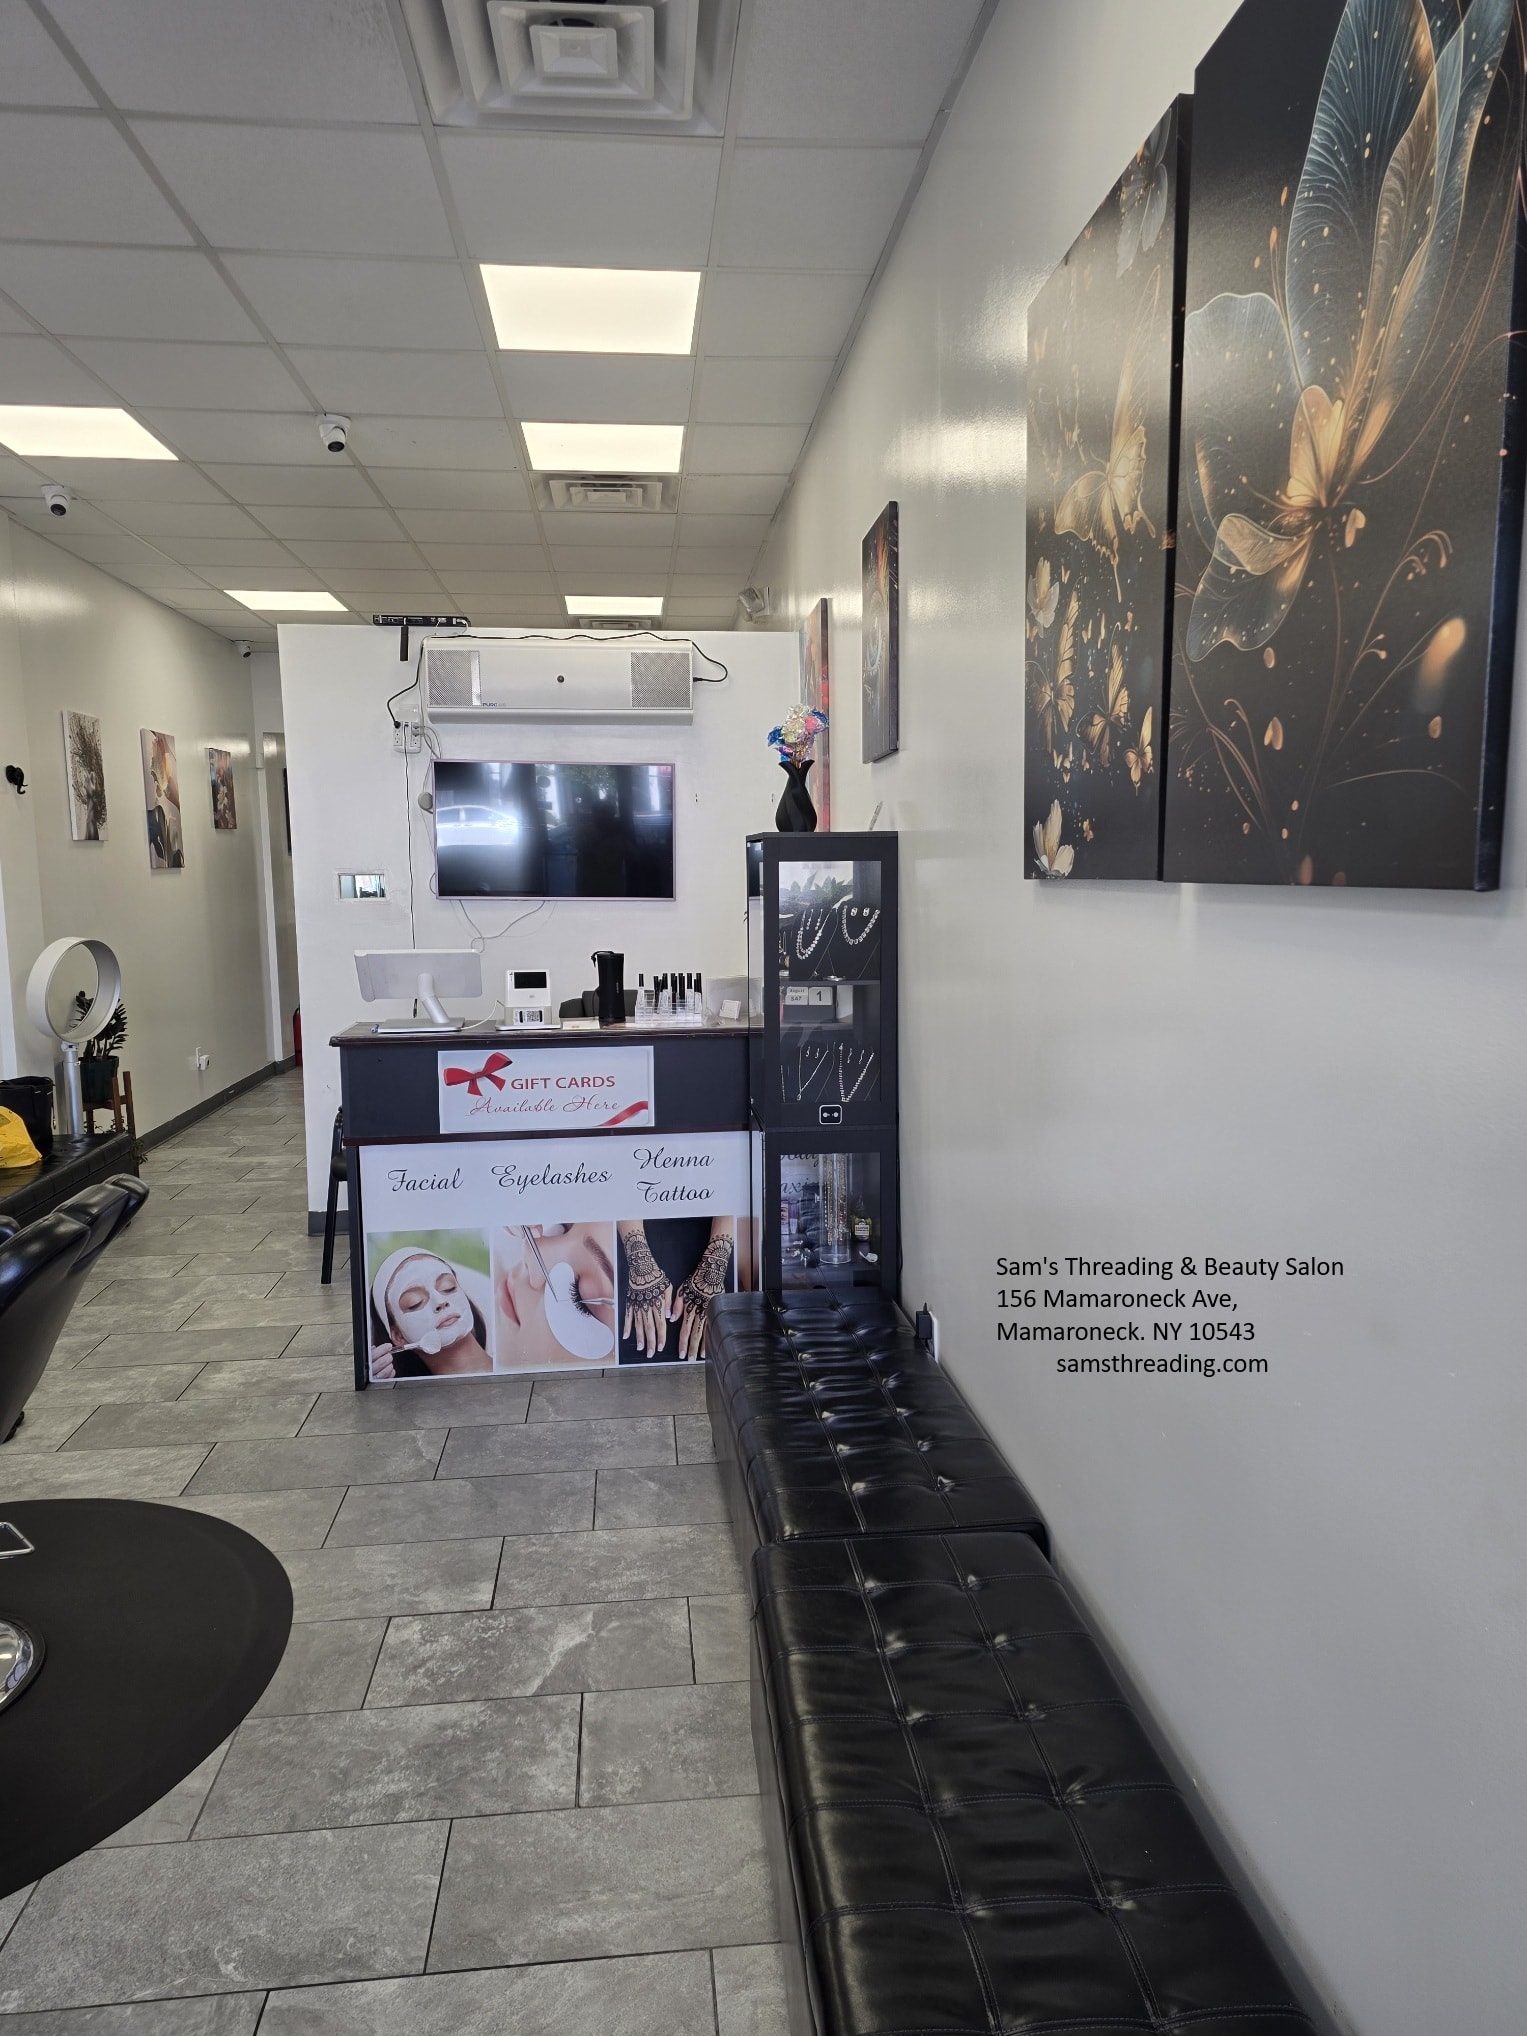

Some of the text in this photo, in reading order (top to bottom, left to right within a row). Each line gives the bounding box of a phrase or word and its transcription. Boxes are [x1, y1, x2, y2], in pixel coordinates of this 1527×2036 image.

[816, 990, 822, 1001] 1
[510, 1075, 616, 1090] GIFT CARDS
[469, 1094, 620, 1115] Available Here
[633, 1146, 714, 1170] Henna
[387, 1167, 464, 1192] Facial
[491, 1163, 613, 1195] Eyelashes
[636, 1180, 714, 1203] Tattoo
